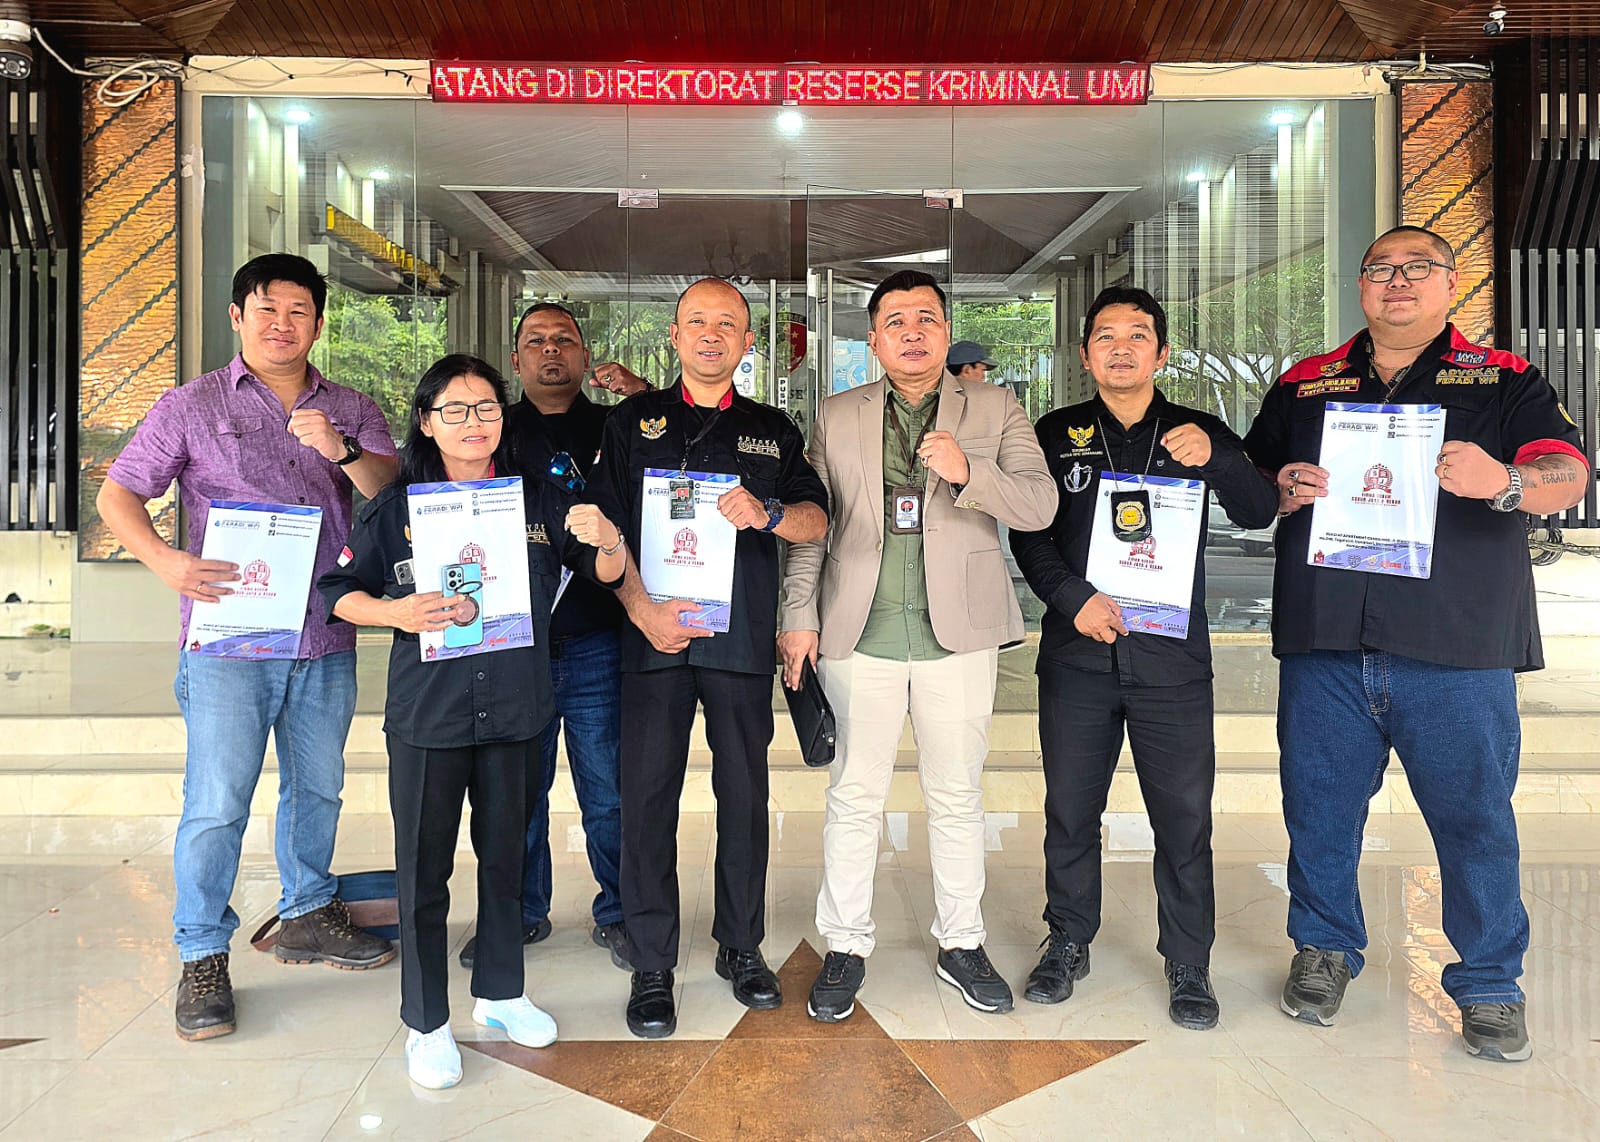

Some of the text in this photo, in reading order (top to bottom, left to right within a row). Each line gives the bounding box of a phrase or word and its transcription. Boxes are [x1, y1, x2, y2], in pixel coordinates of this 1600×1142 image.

[435, 67, 539, 98] ATANG
[546, 68, 574, 98] DI
[585, 69, 777, 100] DIREKTORAT
[786, 69, 921, 100] RESERSE
[929, 69, 1079, 100] KRIMINAL
